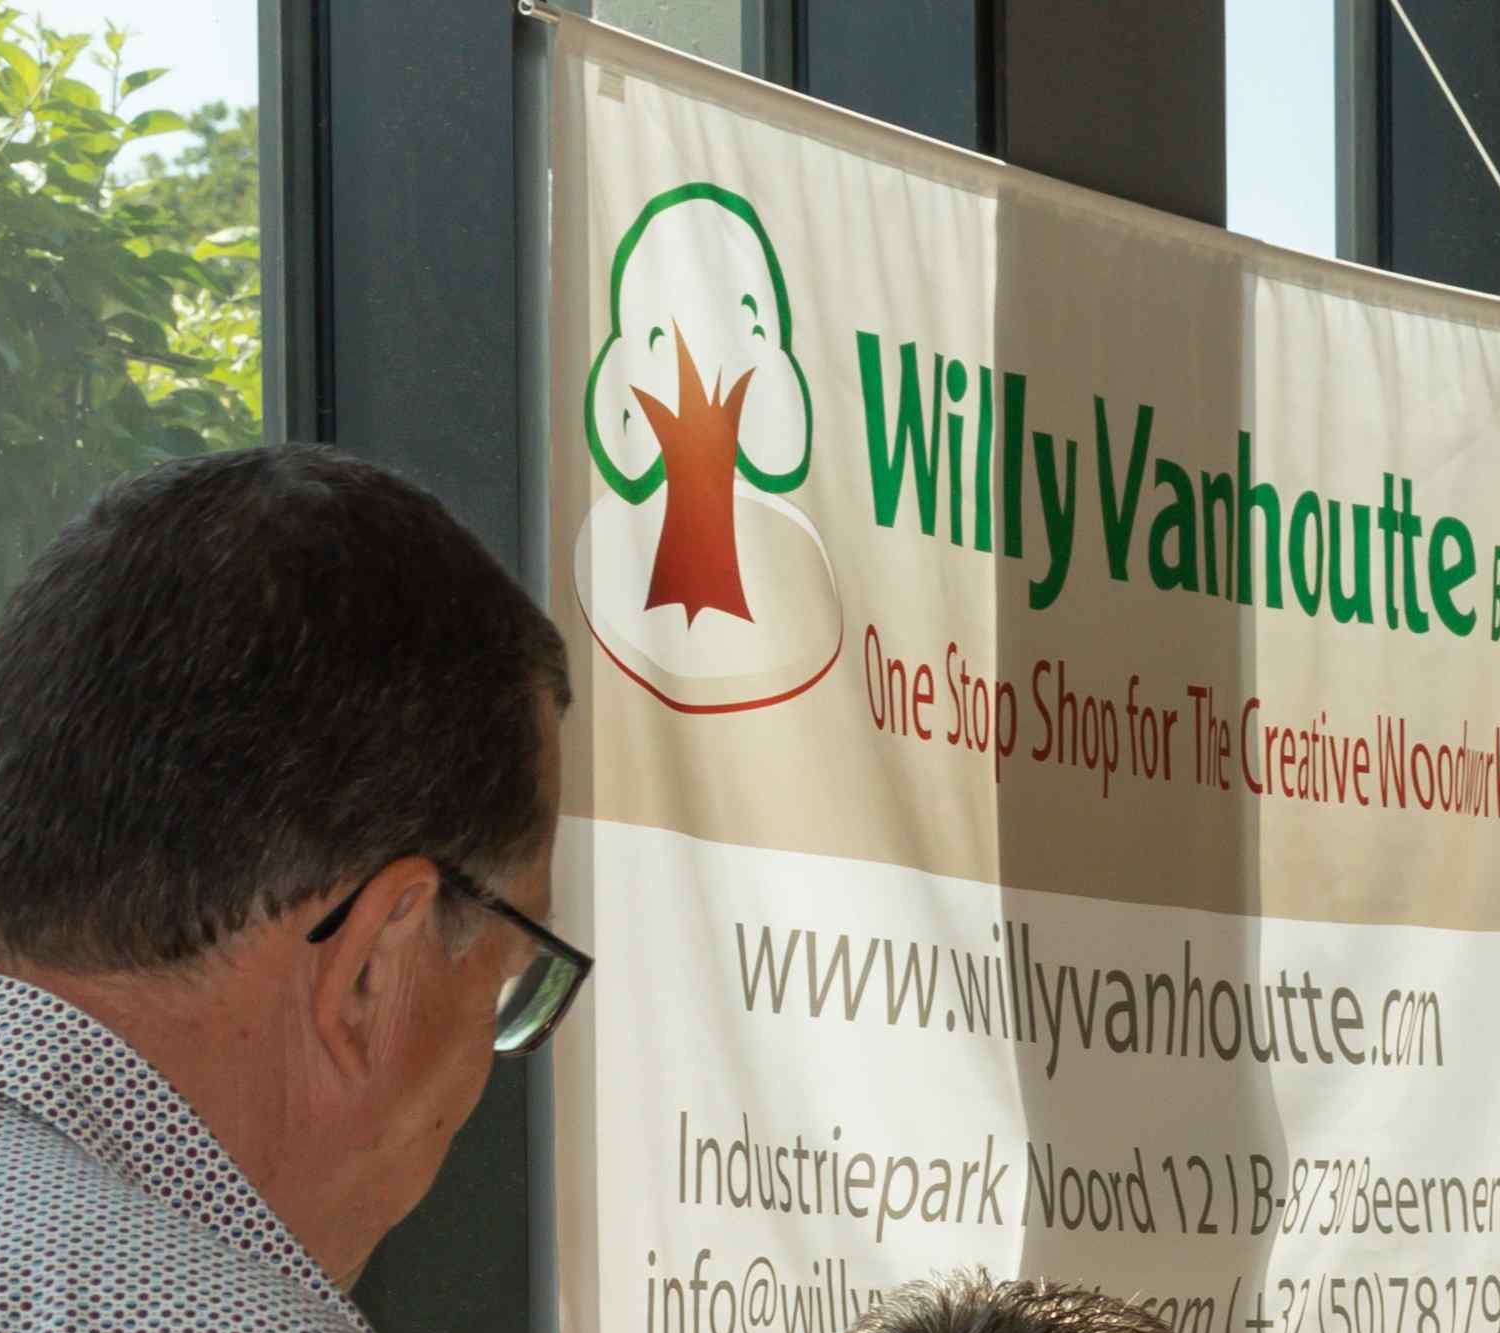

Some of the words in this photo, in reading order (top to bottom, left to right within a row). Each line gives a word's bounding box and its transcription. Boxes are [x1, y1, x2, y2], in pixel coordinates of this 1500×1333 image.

[856, 330, 1077, 610] Willy
[1093, 393, 1478, 639] Vanhoutte
[864, 623, 934, 741] One
[946, 641, 1017, 784] Stop
[1031, 659, 1119, 799] Shop
[1126, 674, 1178, 782] for
[1187, 684, 1231, 791] The
[1240, 696, 1371, 807] Creative
[735, 920, 1445, 1080] www.willyvanhoutte.com
[678, 1111, 1010, 1243] Industriepark
[1021, 1141, 1157, 1234] Noord
[1161, 1155, 1218, 1235] 12
